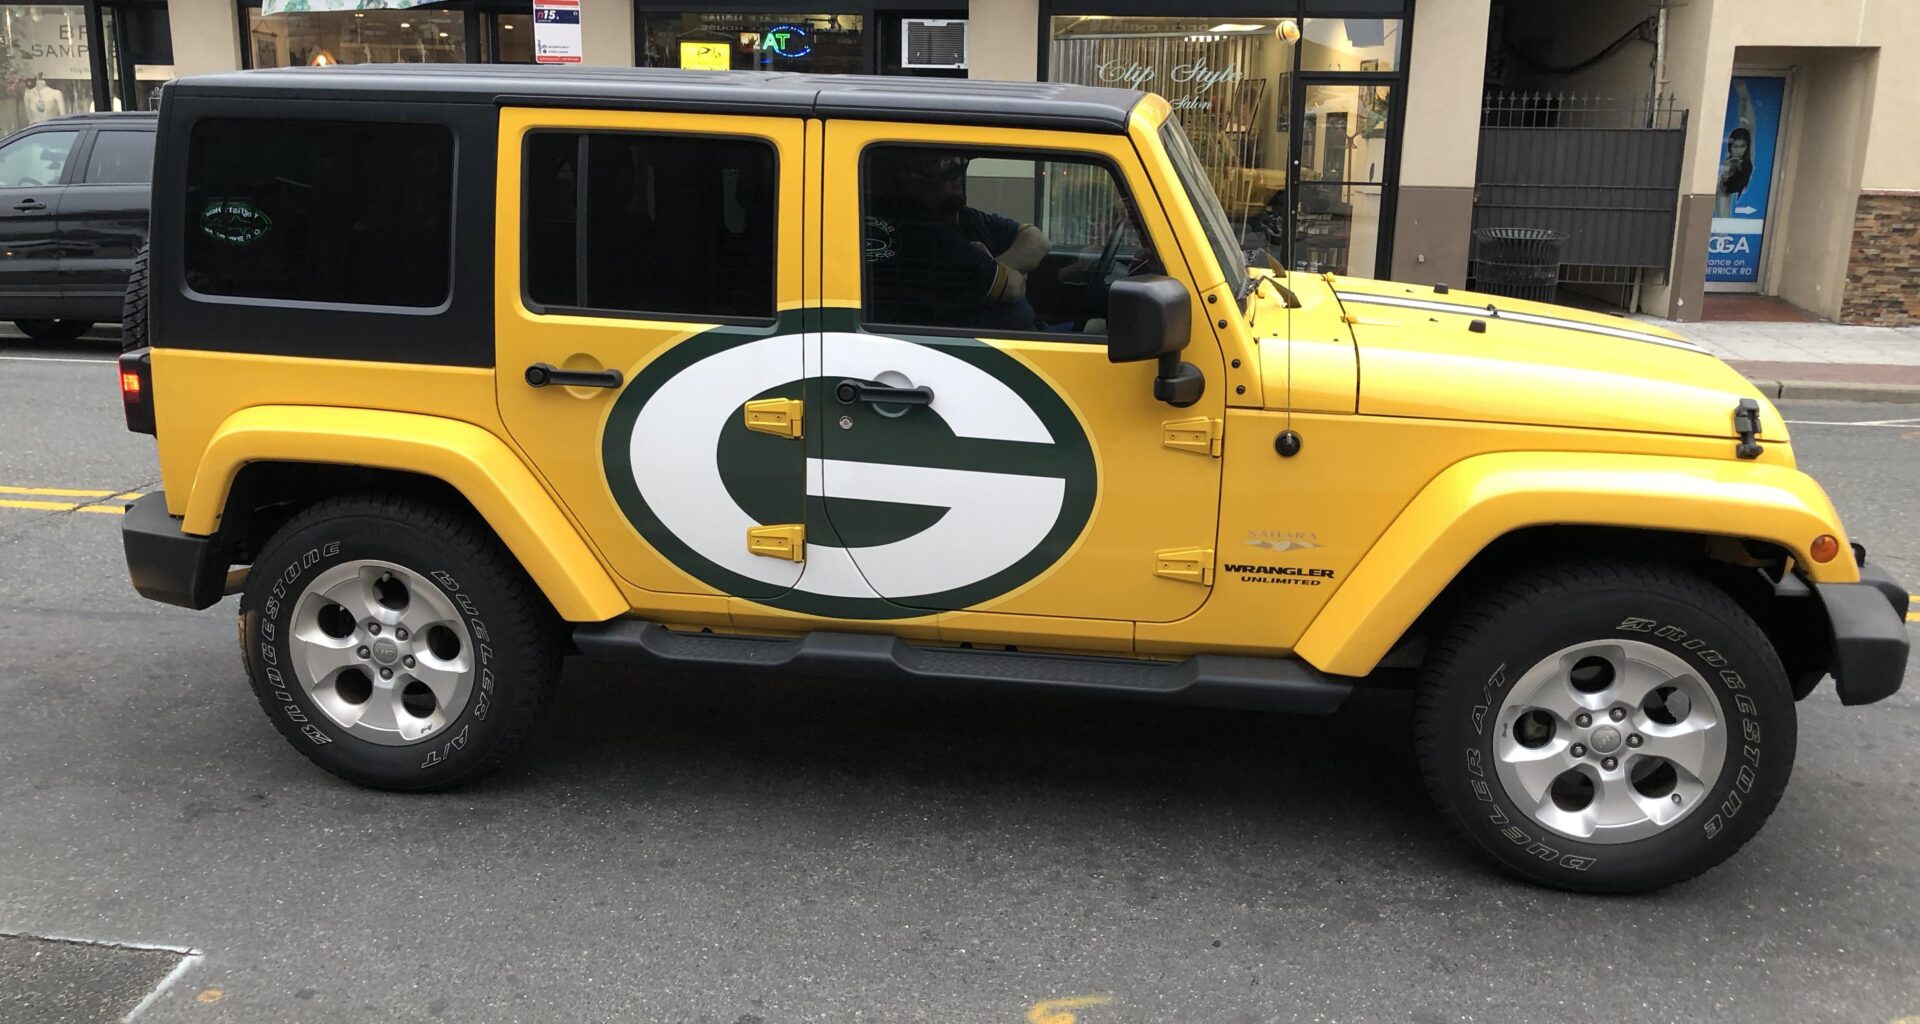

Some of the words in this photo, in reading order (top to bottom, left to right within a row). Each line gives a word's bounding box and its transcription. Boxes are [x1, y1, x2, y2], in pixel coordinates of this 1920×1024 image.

[1096, 59, 1155, 90] Clip
[1170, 57, 1244, 94] Style
[1168, 95, 1213, 110] Salon
[1706, 267, 1738, 275] ERRICK
[1739, 268, 1752, 276] RD
[629, 331, 1067, 600] G
[1247, 529, 1317, 540] SAHARA
[1224, 563, 1335, 579] WRANGLER
[1240, 576, 1321, 586] UNLIMITED
[261, 540, 341, 746] BRIDGESTONE
[431, 569, 496, 722] DUELER
[1472, 662, 1507, 735] A/T
[421, 723, 469, 769] A/T
[1615, 616, 1762, 841] BRIDGESTONE
[1466, 748, 1597, 872] DUELER
